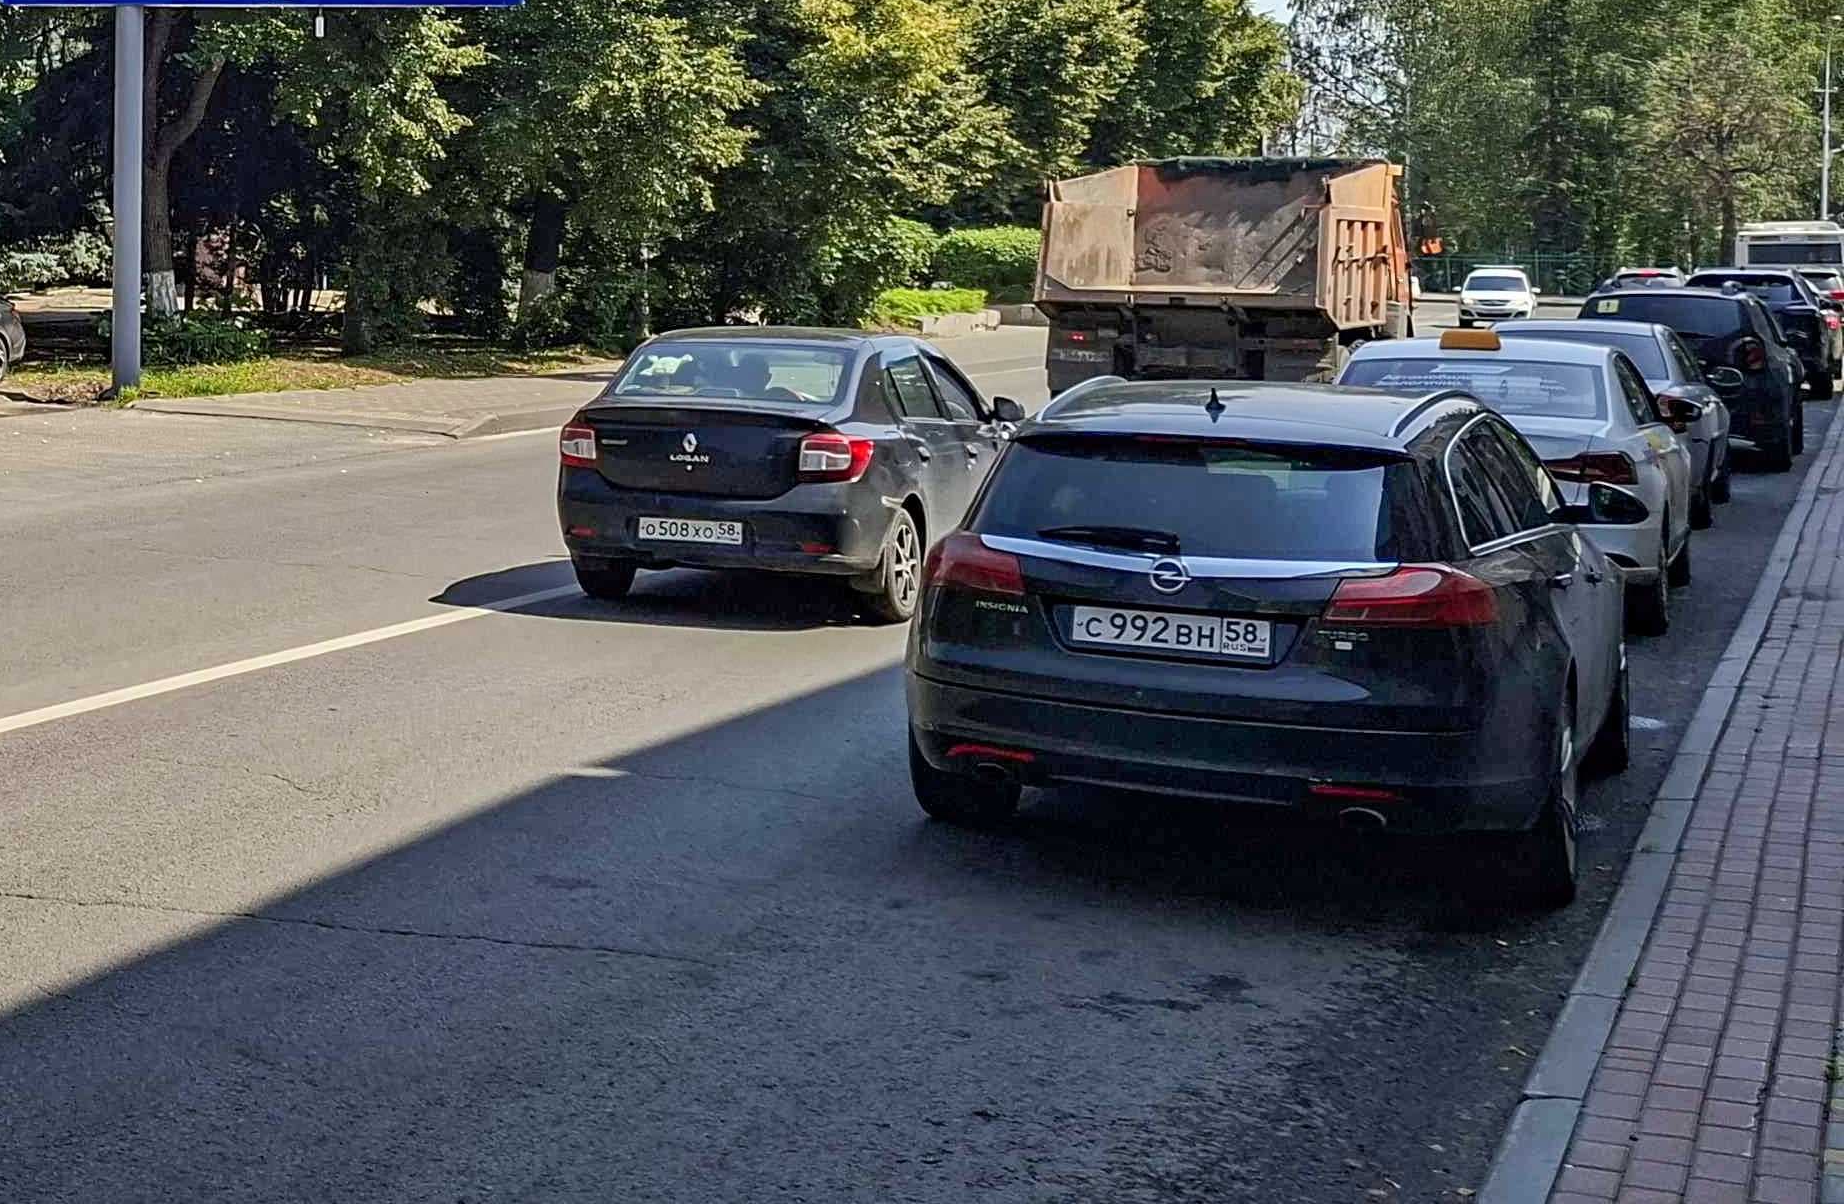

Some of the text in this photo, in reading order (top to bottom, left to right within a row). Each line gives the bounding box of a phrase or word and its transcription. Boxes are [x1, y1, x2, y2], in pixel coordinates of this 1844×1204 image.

[669, 454, 709, 463] LOGAN
[975, 600, 1029, 614] INSIGNIA
[1223, 643, 1247, 653] RUS
